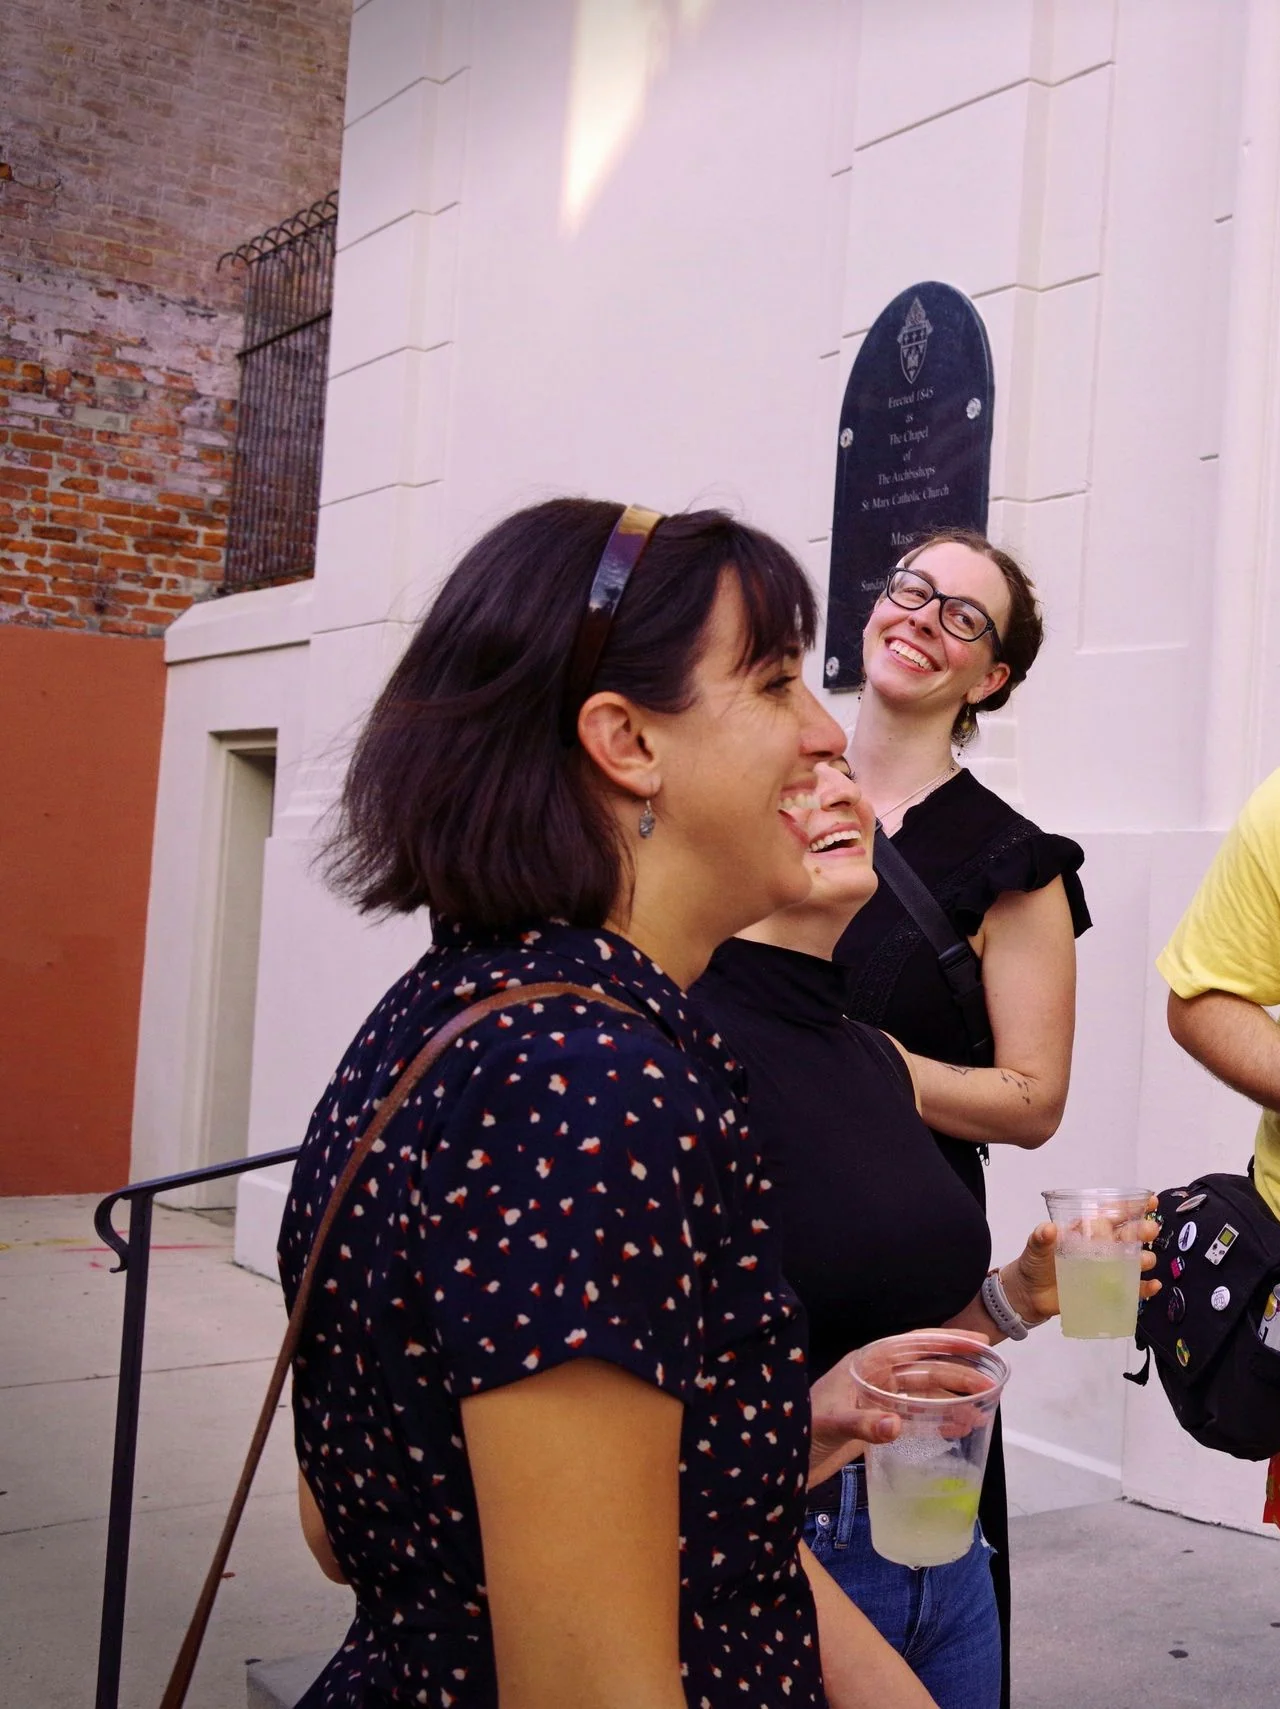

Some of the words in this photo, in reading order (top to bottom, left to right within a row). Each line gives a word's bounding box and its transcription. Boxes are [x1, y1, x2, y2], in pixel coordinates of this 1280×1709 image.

[888, 391, 915, 409] Erected
[905, 413, 914, 424] as
[889, 433, 901, 446] The
[903, 425, 929, 443] Chapel
[902, 448, 913, 462] of
[878, 473, 890, 486] The
[892, 465, 936, 482] Archbishops
[872, 497, 890, 510] Mary
[892, 489, 920, 506] Catholic
[922, 484, 950, 500] Church
